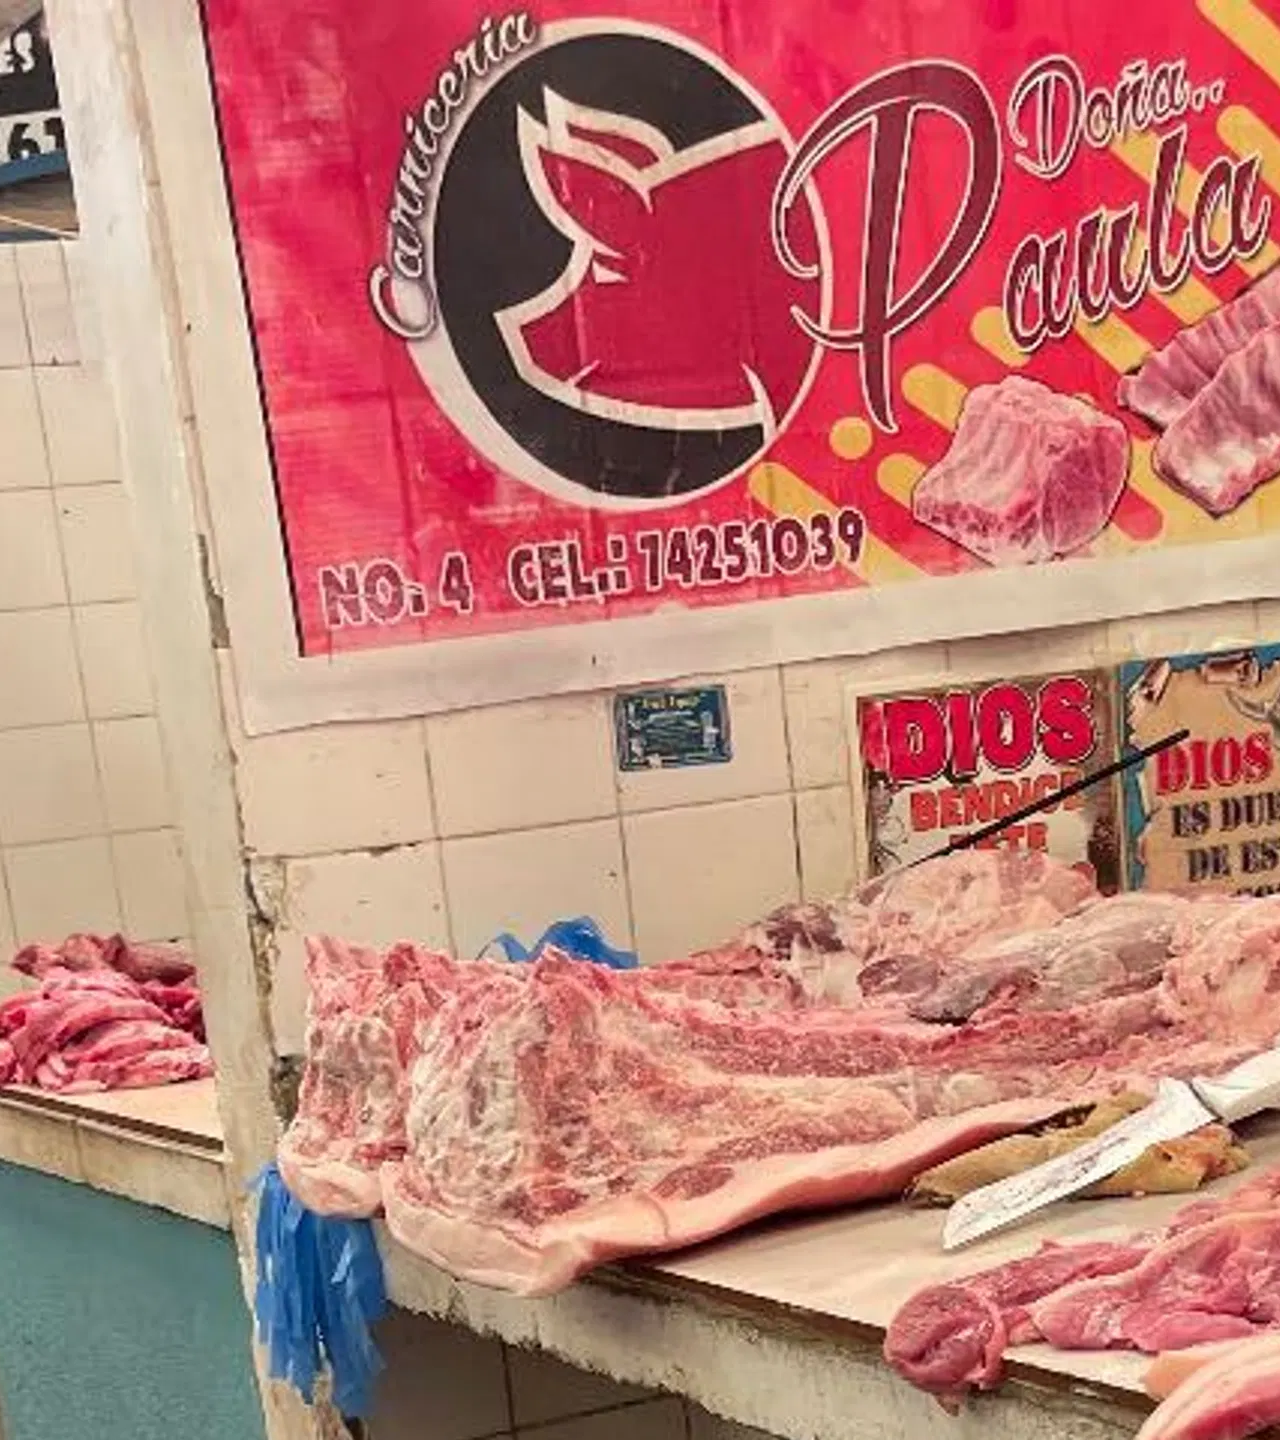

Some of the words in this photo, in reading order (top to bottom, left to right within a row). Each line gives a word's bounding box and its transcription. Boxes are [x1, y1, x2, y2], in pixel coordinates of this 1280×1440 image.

[439, 551, 473, 614] 4
[885, 676, 1096, 784] DIOS
[1155, 732, 1274, 796] DIOS
[1172, 800, 1211, 838] ES
[1188, 843, 1232, 882] DE
